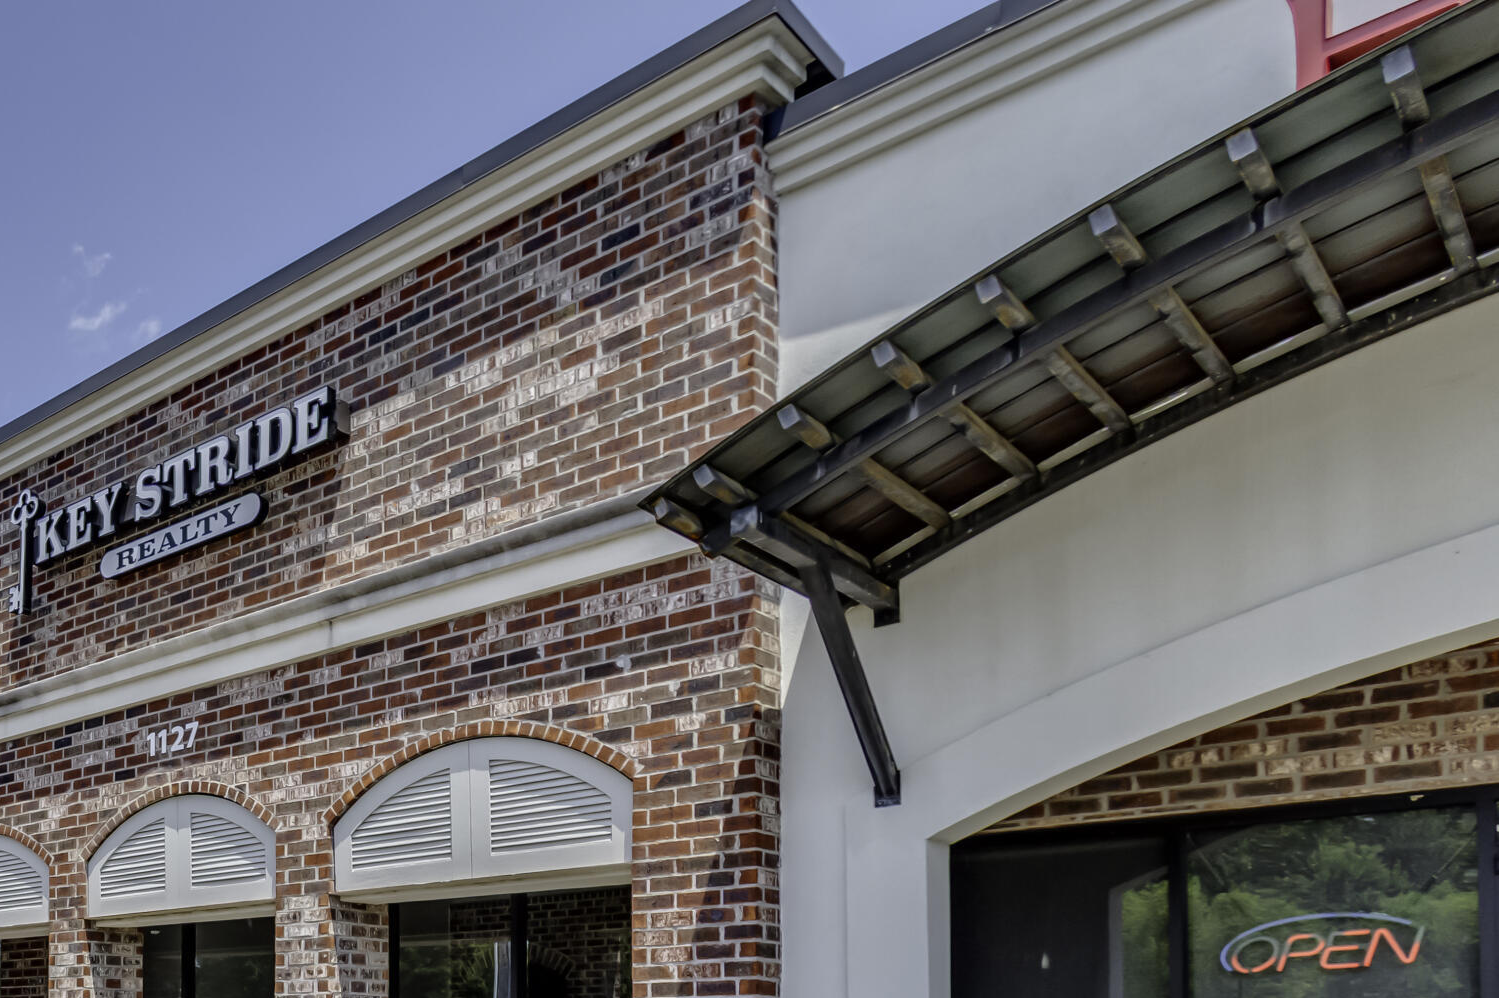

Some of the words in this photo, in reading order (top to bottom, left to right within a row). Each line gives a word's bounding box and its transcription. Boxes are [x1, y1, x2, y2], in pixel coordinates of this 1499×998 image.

[35, 482, 124, 565] KEY
[134, 385, 334, 522] STRIDE
[115, 503, 242, 570] REALTY
[146, 721, 199, 757] 1127
[1231, 926, 1426, 974] OPEN
